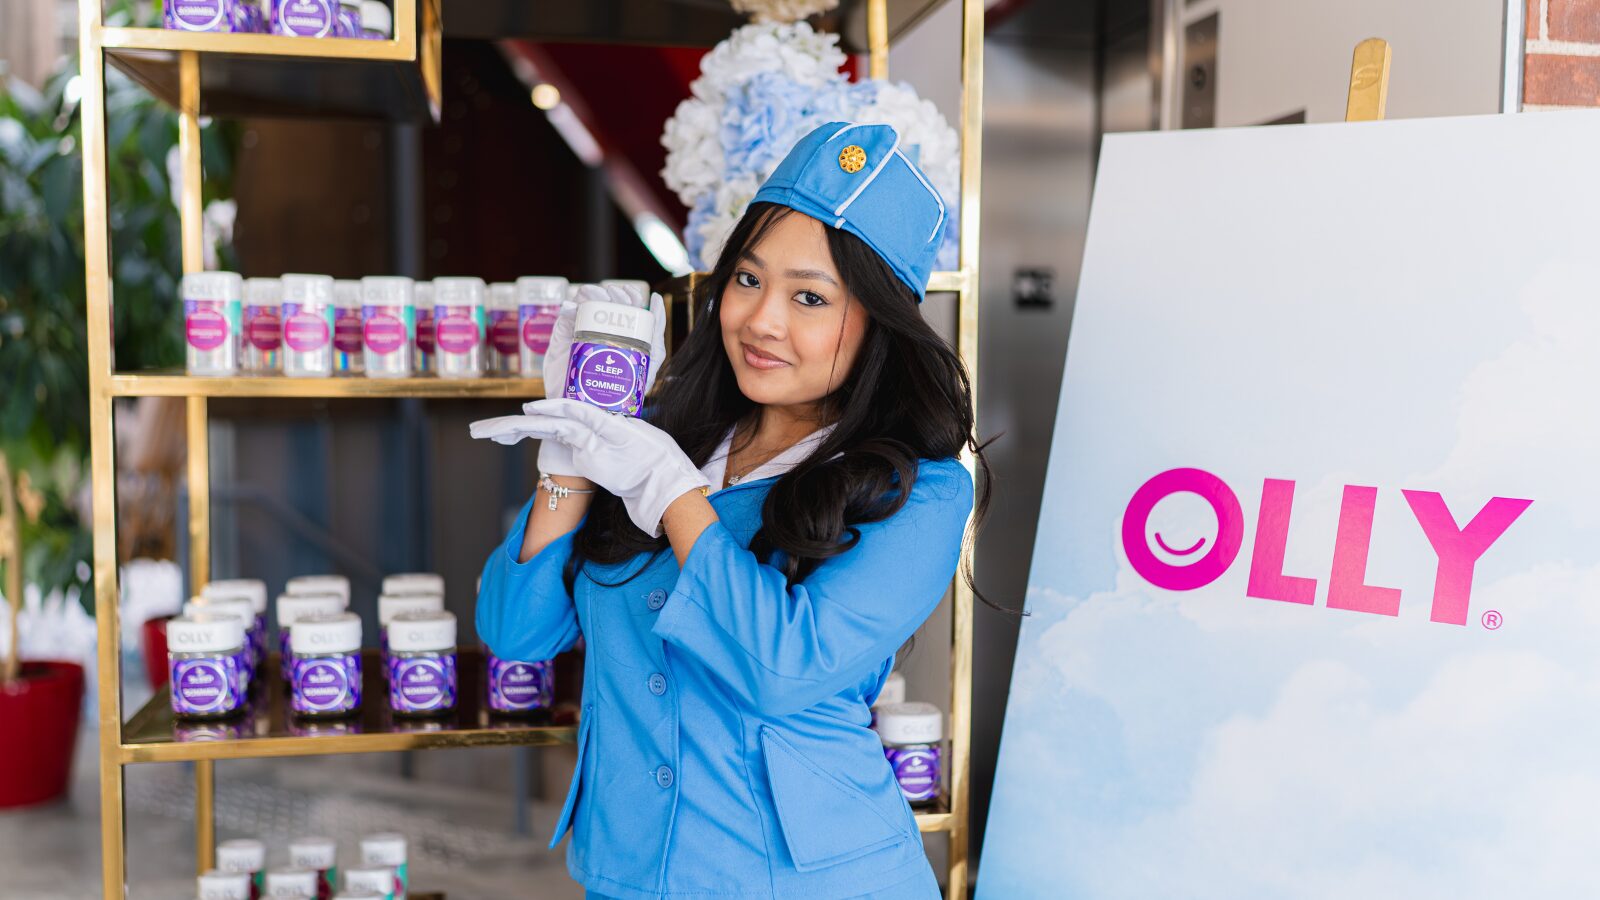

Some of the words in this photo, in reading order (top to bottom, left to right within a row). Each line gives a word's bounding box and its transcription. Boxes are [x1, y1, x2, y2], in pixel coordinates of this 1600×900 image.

[593, 309, 635, 330] OLLY
[595, 364, 623, 376] SLEEP
[585, 378, 627, 393] SOMMEIL
[1122, 467, 1534, 626] OLLY
[178, 631, 214, 644] OLLY
